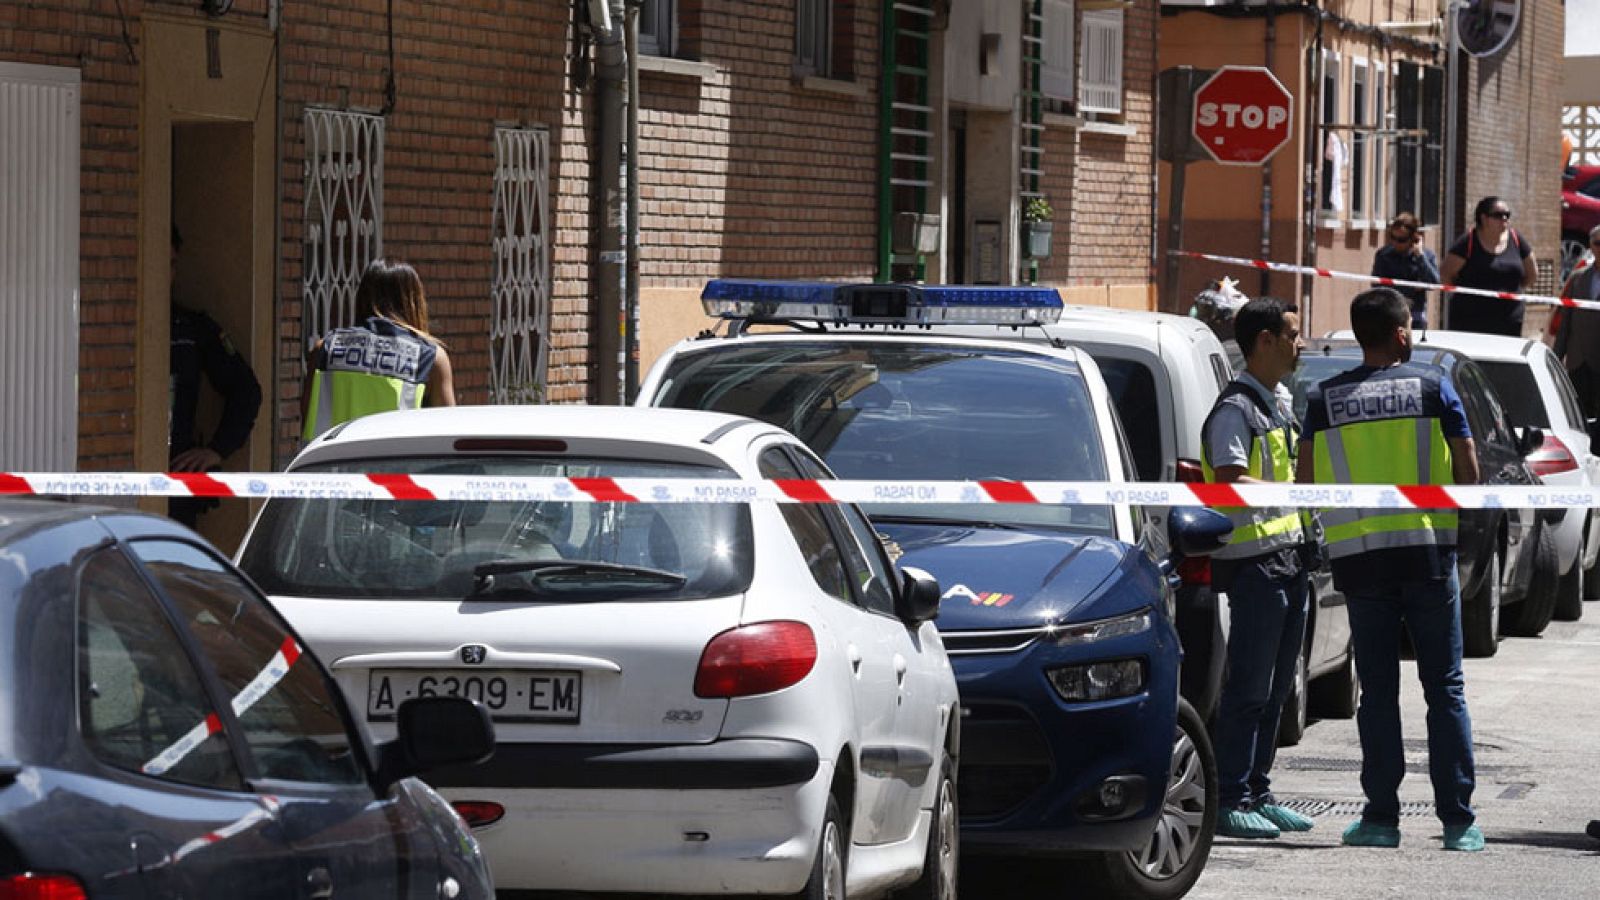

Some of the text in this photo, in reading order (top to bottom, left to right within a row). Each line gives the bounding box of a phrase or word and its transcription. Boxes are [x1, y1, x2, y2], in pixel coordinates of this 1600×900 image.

[1198, 102, 1287, 130] STOP
[329, 347, 413, 376] POLICIA
[1331, 393, 1418, 421] POLICIA
[1106, 490, 1169, 503] NO PASAR
[1528, 494, 1593, 505] NO PASAR
